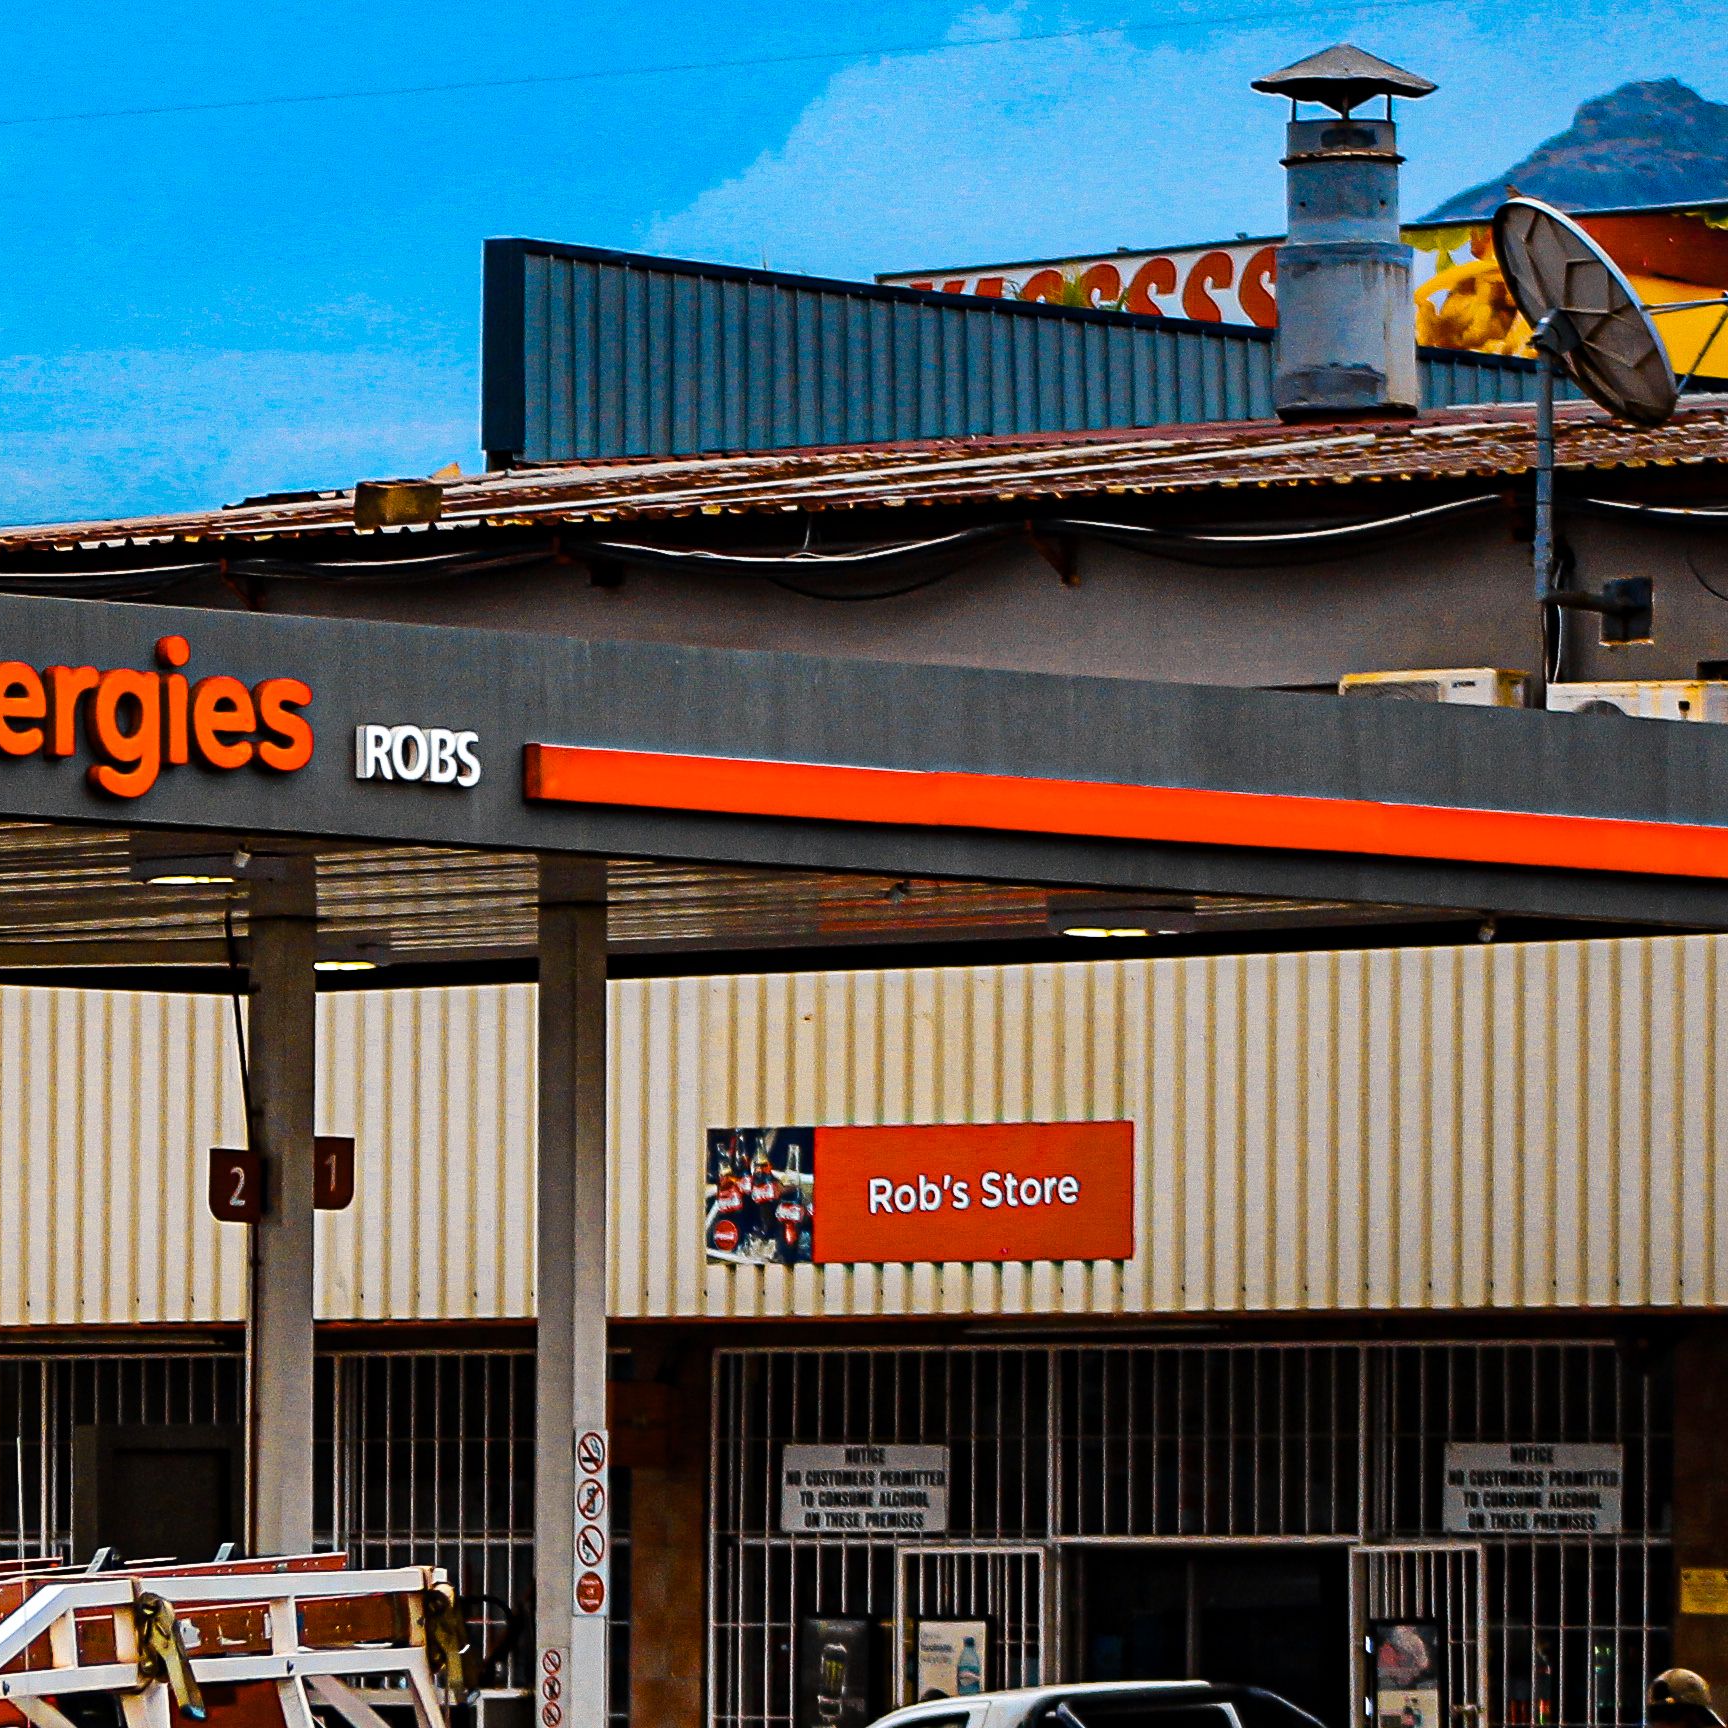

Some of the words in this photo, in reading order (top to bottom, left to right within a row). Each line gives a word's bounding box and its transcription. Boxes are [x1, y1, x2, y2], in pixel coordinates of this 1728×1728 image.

[356, 723, 482, 788] ROBS
[229, 1166, 246, 1206] 2
[324, 1154, 336, 1192] 1
[869, 1174, 971, 1214] Rob's
[981, 1170, 1080, 1209] Store
[845, 1447, 886, 1463] NOTICE
[786, 1470, 801, 1485] NO
[805, 1470, 875, 1486] CUSTOMERS
[879, 1470, 944, 1486] PERMITTED
[800, 1491, 814, 1507] TO
[818, 1491, 873, 1507] CONSUME
[804, 1512, 820, 1528] ON
[825, 1512, 860, 1528] THESE
[865, 1512, 924, 1529] PREMISES
